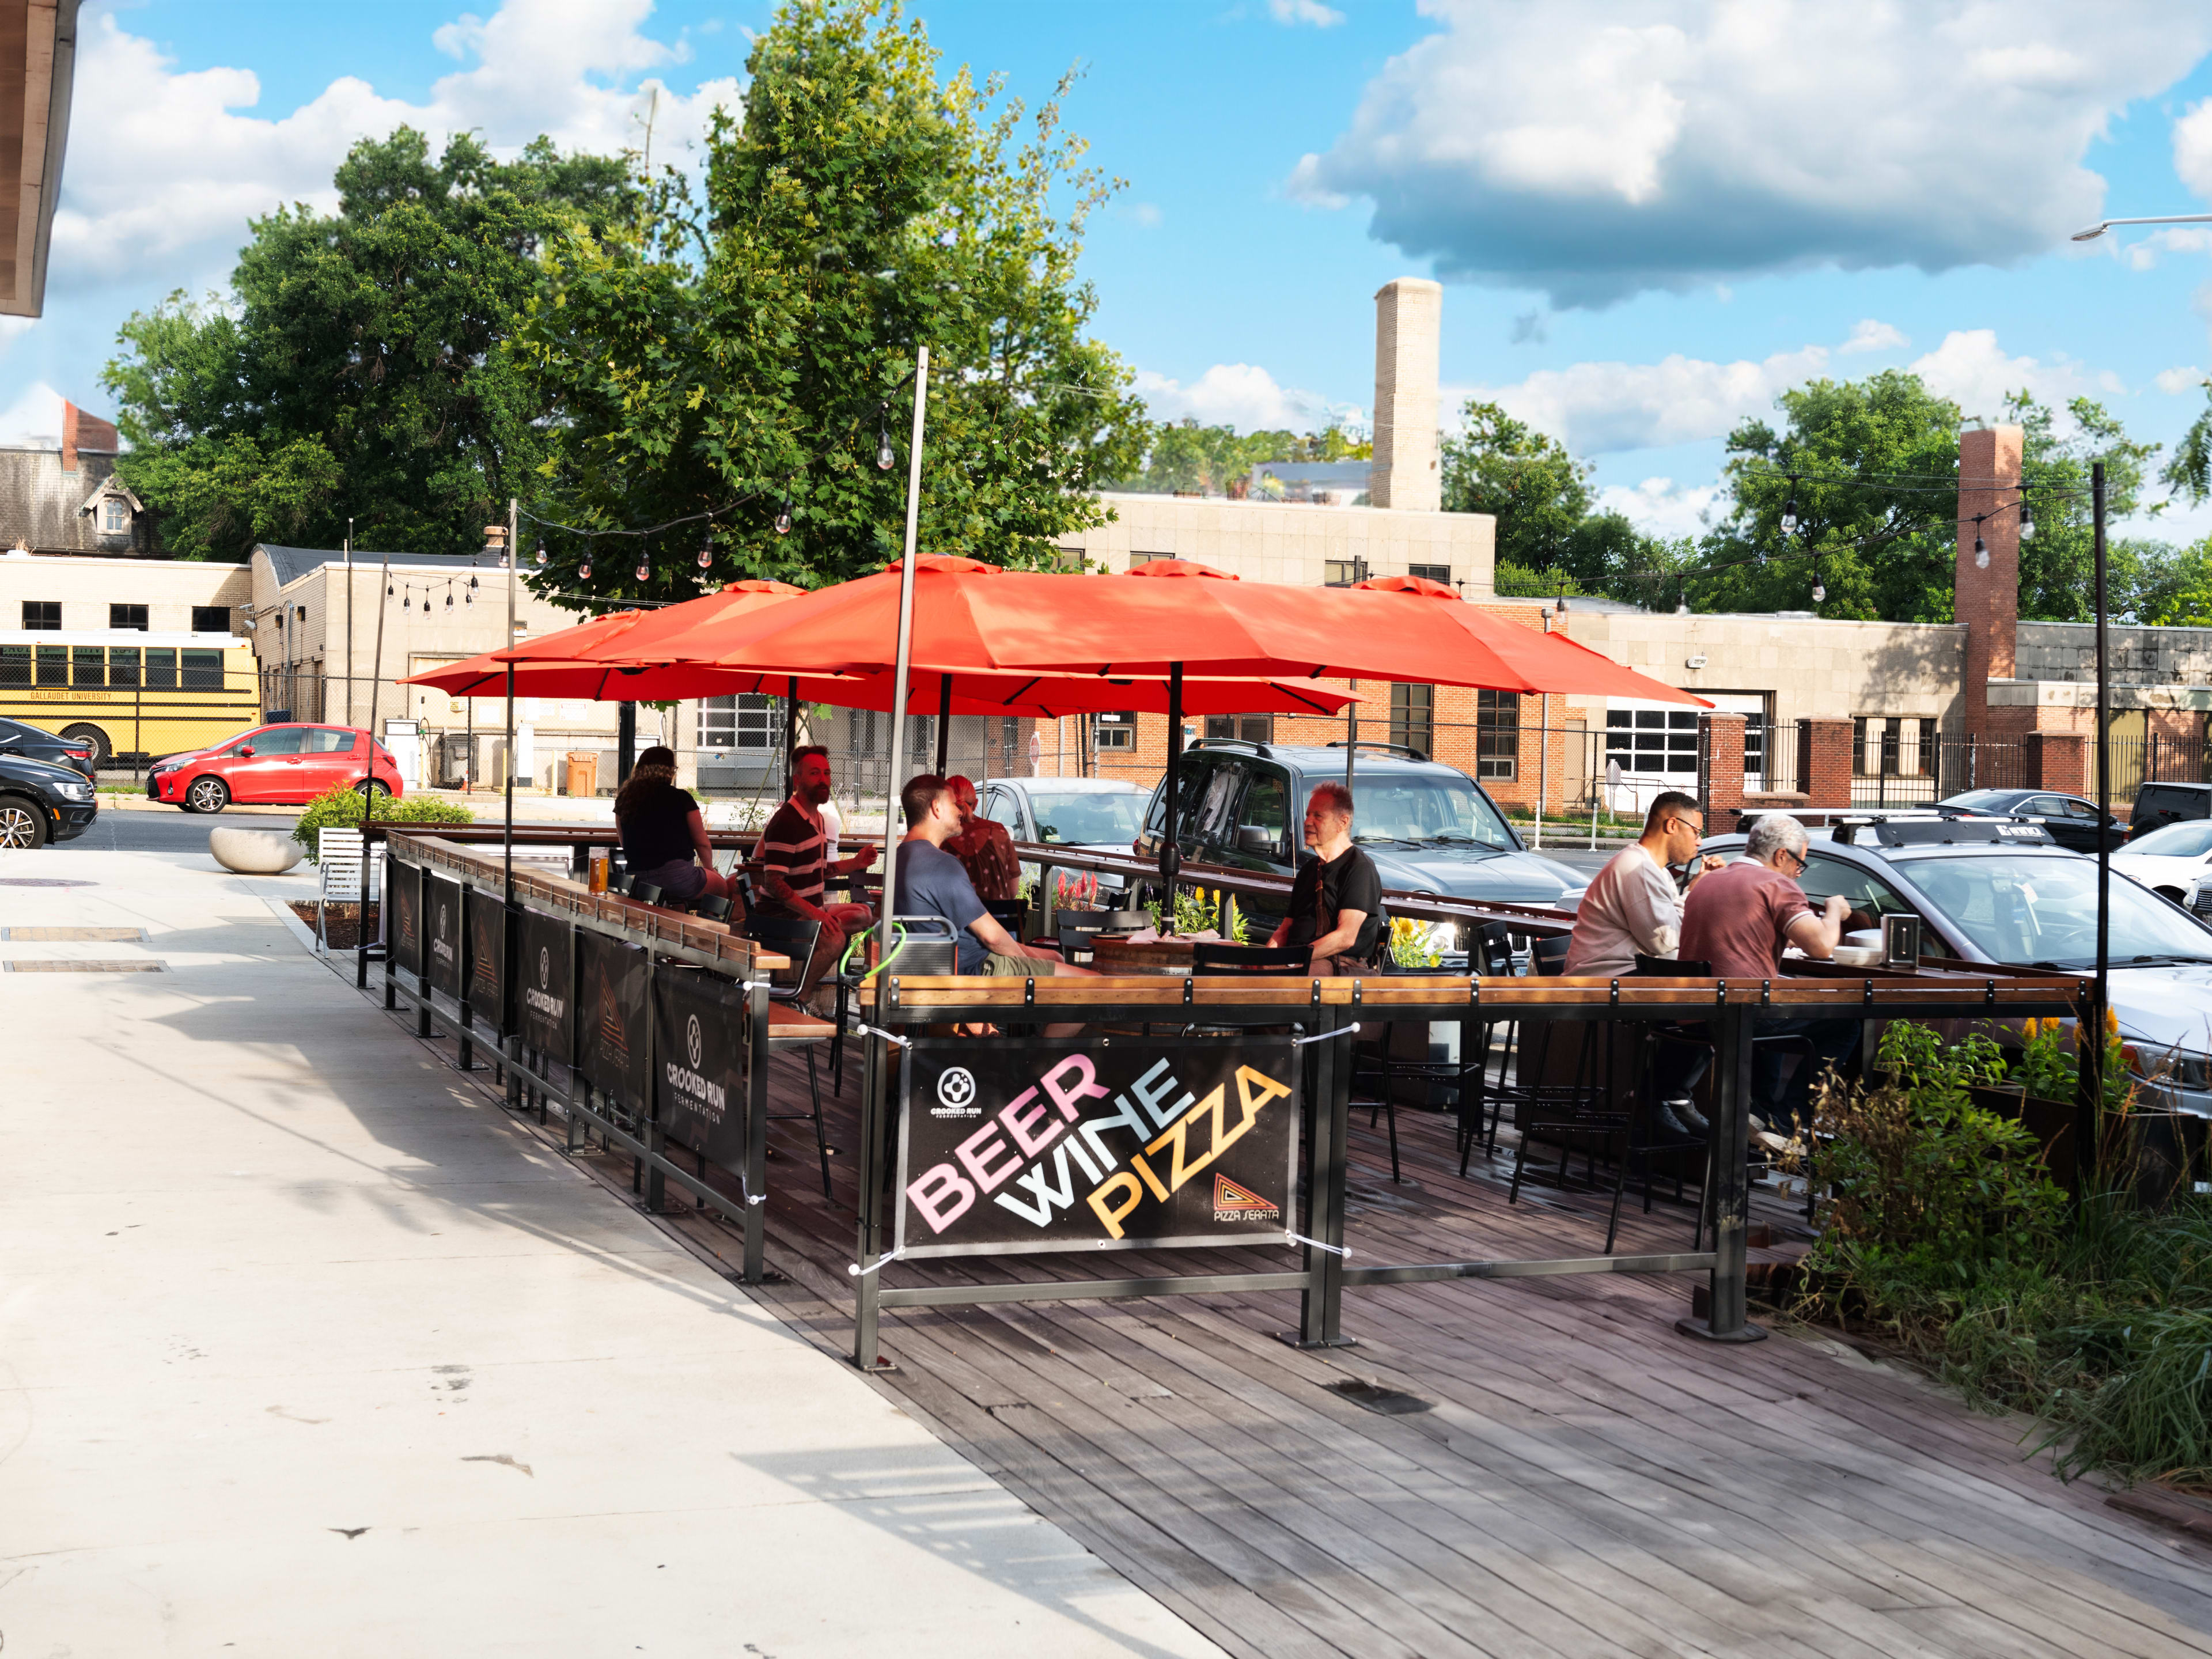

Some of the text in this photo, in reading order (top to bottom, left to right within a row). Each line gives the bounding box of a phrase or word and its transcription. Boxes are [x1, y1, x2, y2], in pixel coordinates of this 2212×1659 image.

[1031, 745, 1039, 755] STOP
[527, 987, 563, 1018] CROOKED RUN
[667, 1062, 725, 1111] CROOKED RUN
[675, 1092, 720, 1124] FERMENTATION
[906, 1054, 1110, 1234] BEER
[994, 1057, 1195, 1227] WINE
[1086, 1065, 1292, 1240] PIZZA
[1214, 1210, 1279, 1221] PIZZA SERATA
